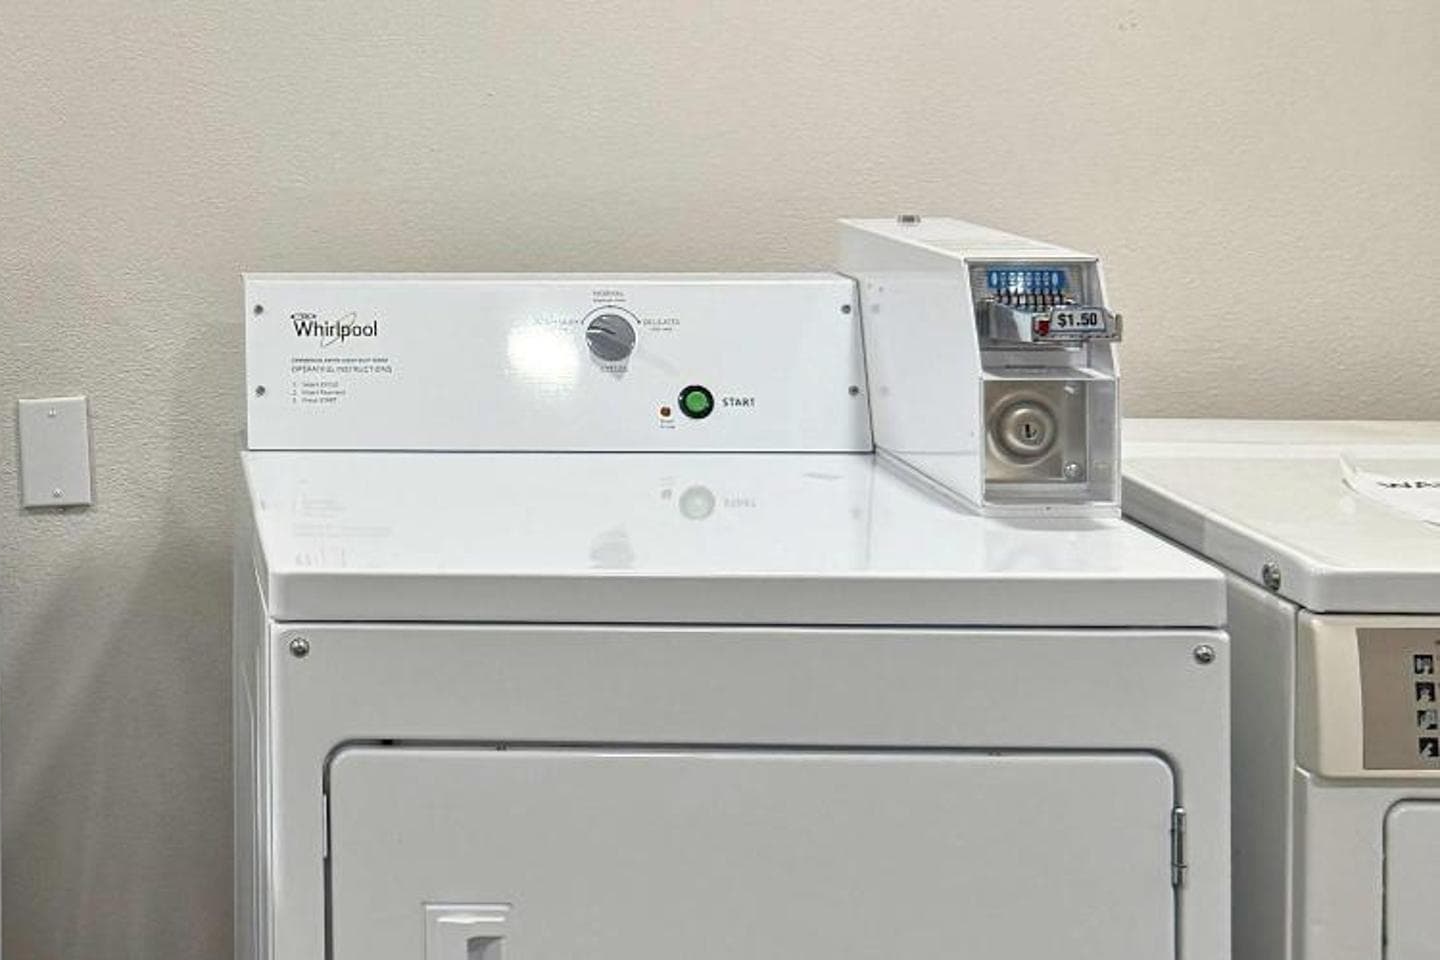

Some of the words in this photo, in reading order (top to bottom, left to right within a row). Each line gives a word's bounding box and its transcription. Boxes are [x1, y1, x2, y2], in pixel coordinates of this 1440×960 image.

[1057, 312, 1098, 328] $1.50
[293, 319, 378, 342] Whirlpool
[721, 397, 755, 407] START
